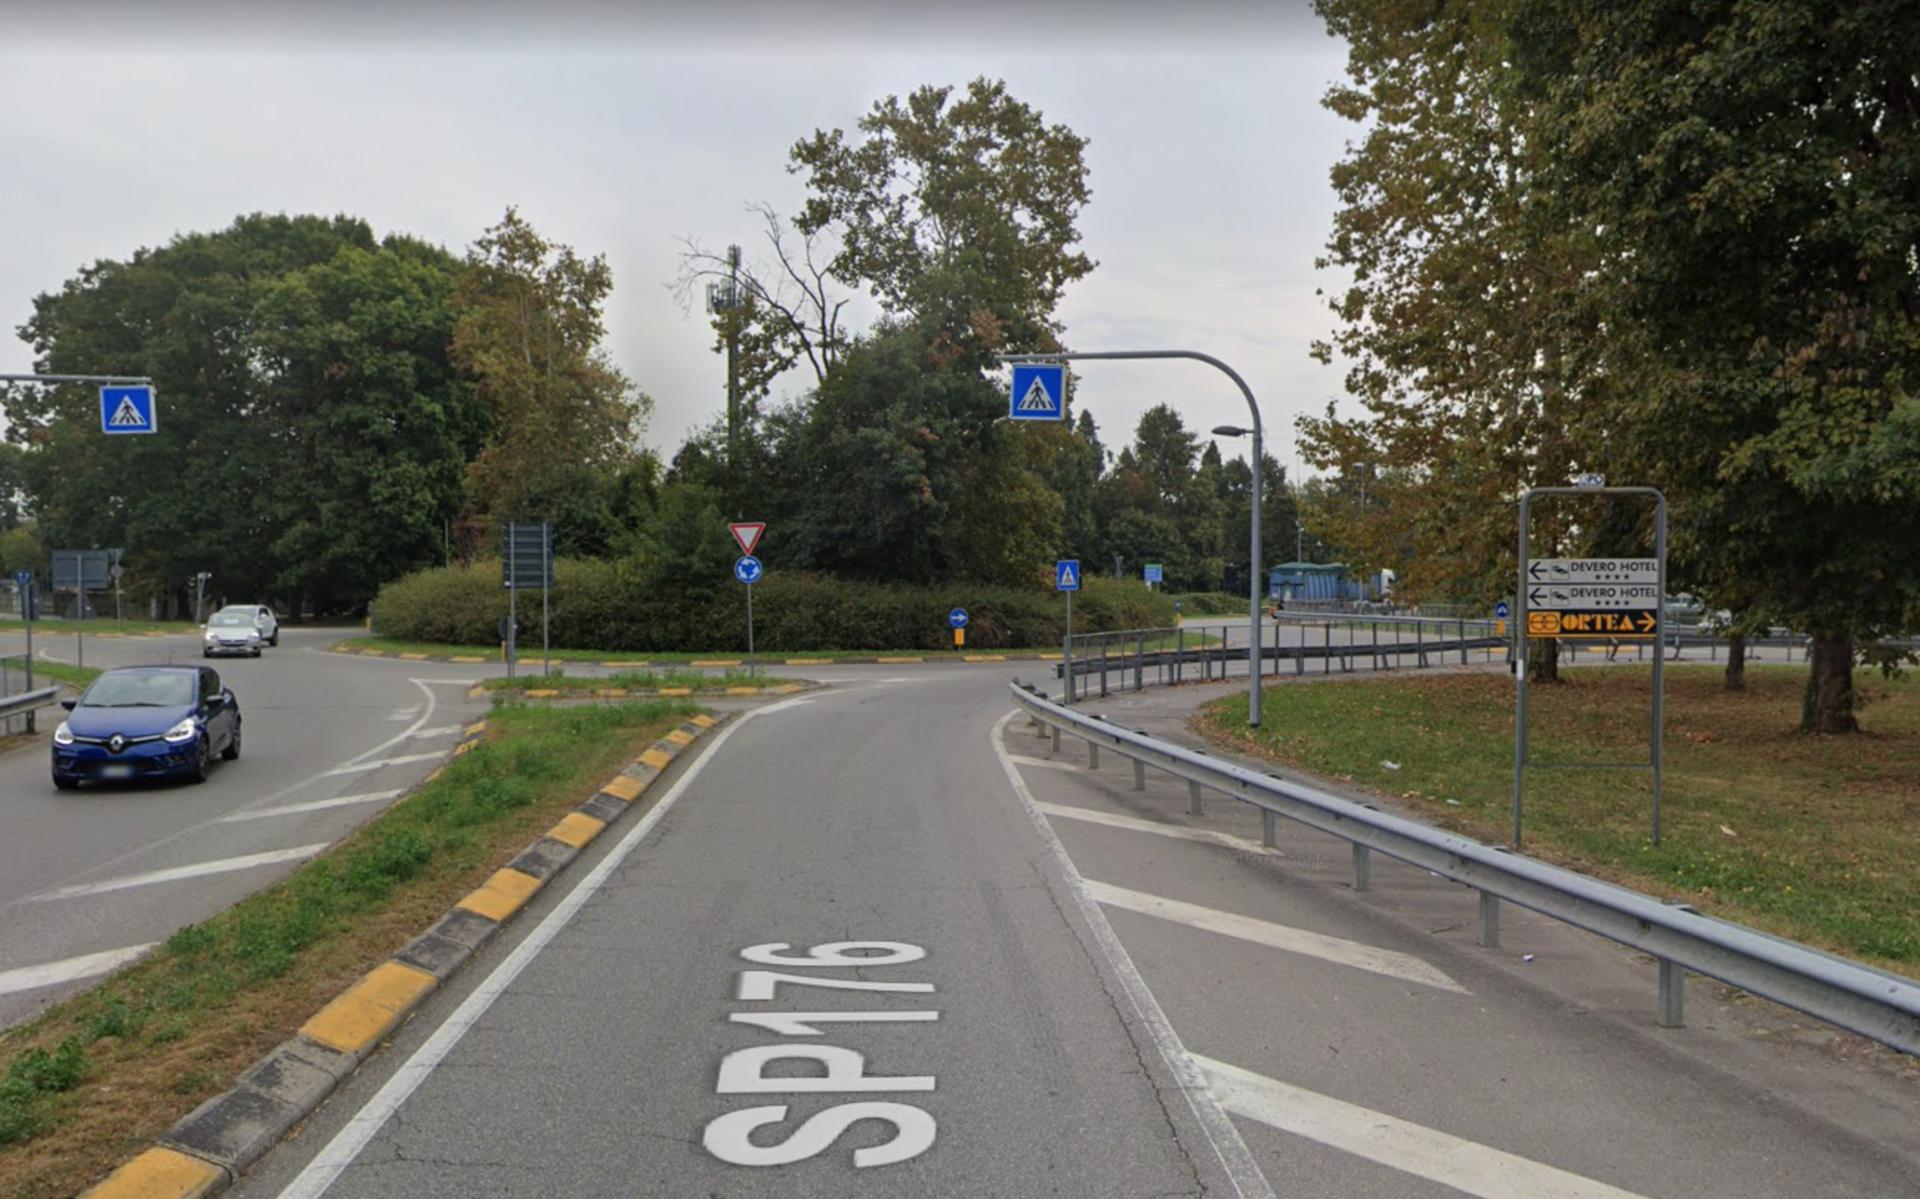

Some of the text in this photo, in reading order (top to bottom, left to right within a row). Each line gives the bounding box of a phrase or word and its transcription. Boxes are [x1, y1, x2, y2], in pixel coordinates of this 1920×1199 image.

[1571, 562, 1657, 572] DEVERO HOTEL
[1571, 588, 1657, 598] DEVERO HOTEL
[1562, 614, 1634, 630] ORTEA
[703, 941, 938, 1167] SP176
